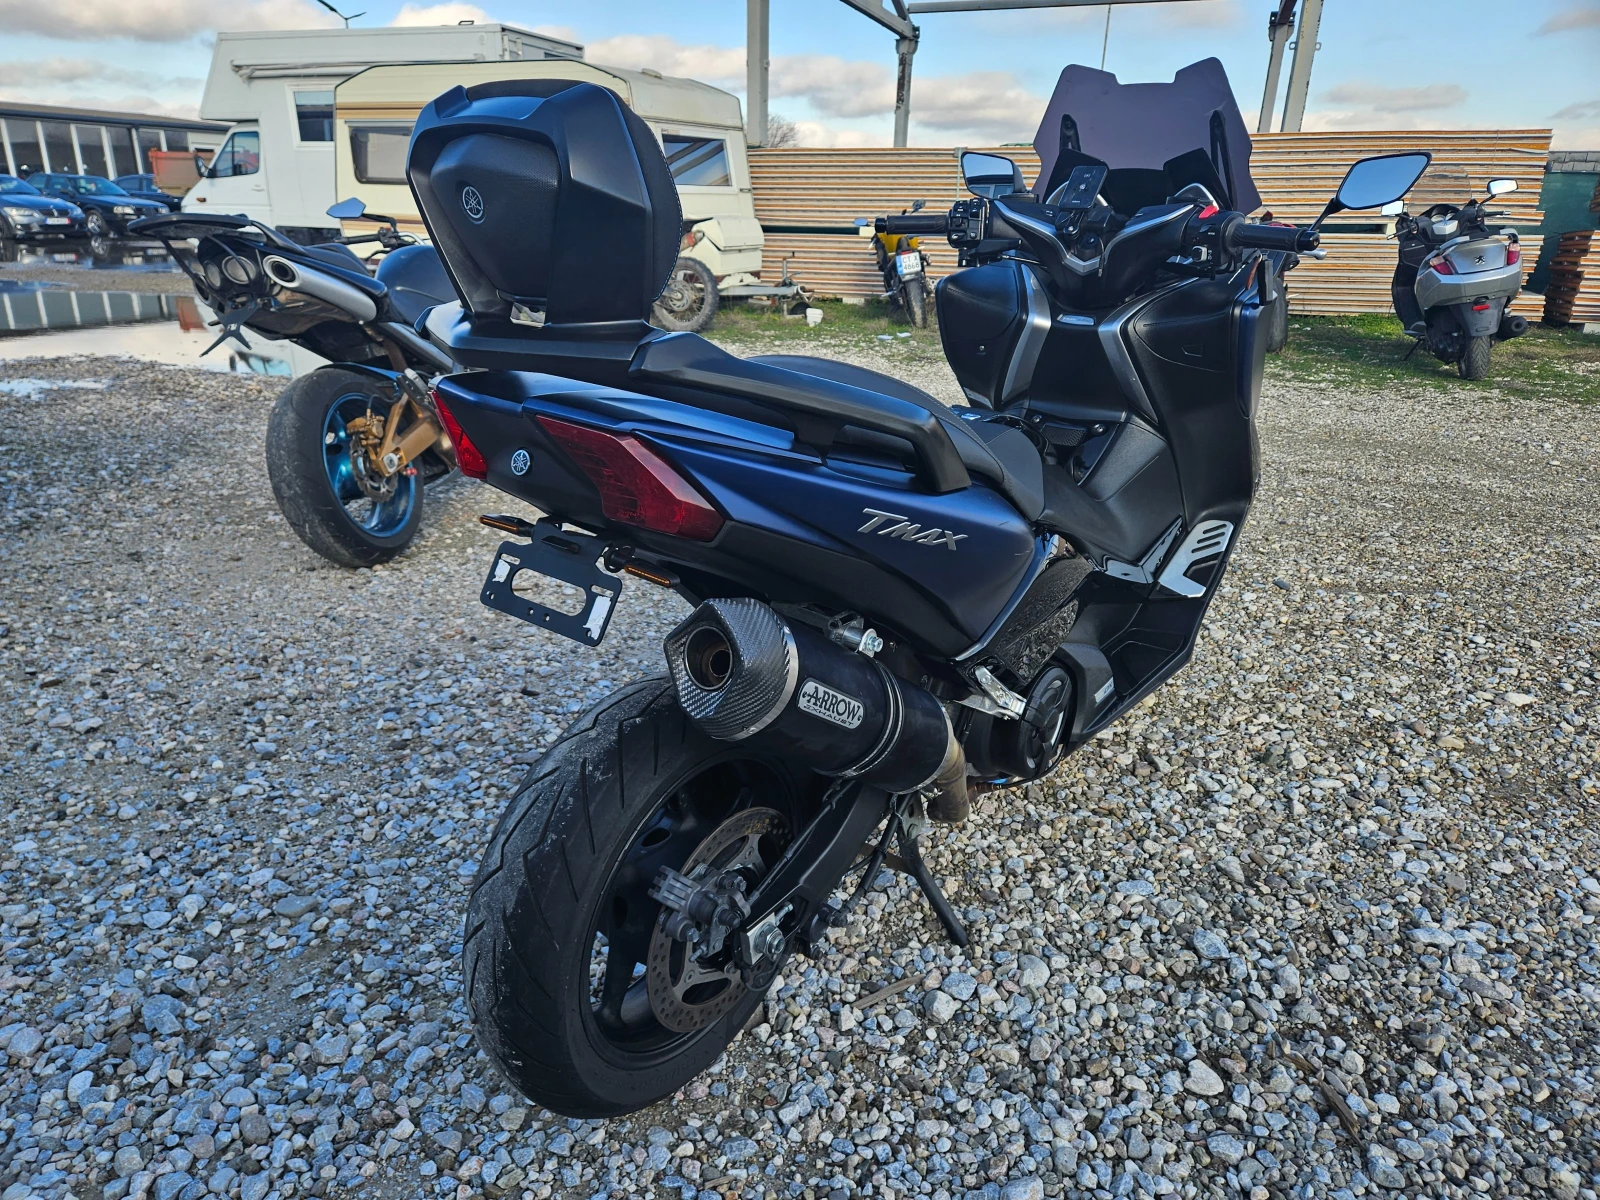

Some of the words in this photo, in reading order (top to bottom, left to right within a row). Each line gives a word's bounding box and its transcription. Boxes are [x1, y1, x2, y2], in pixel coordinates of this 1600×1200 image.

[857, 507, 969, 551] TMAX
[803, 703, 854, 726] EXHAUST
[805, 685, 861, 721] ARROW
